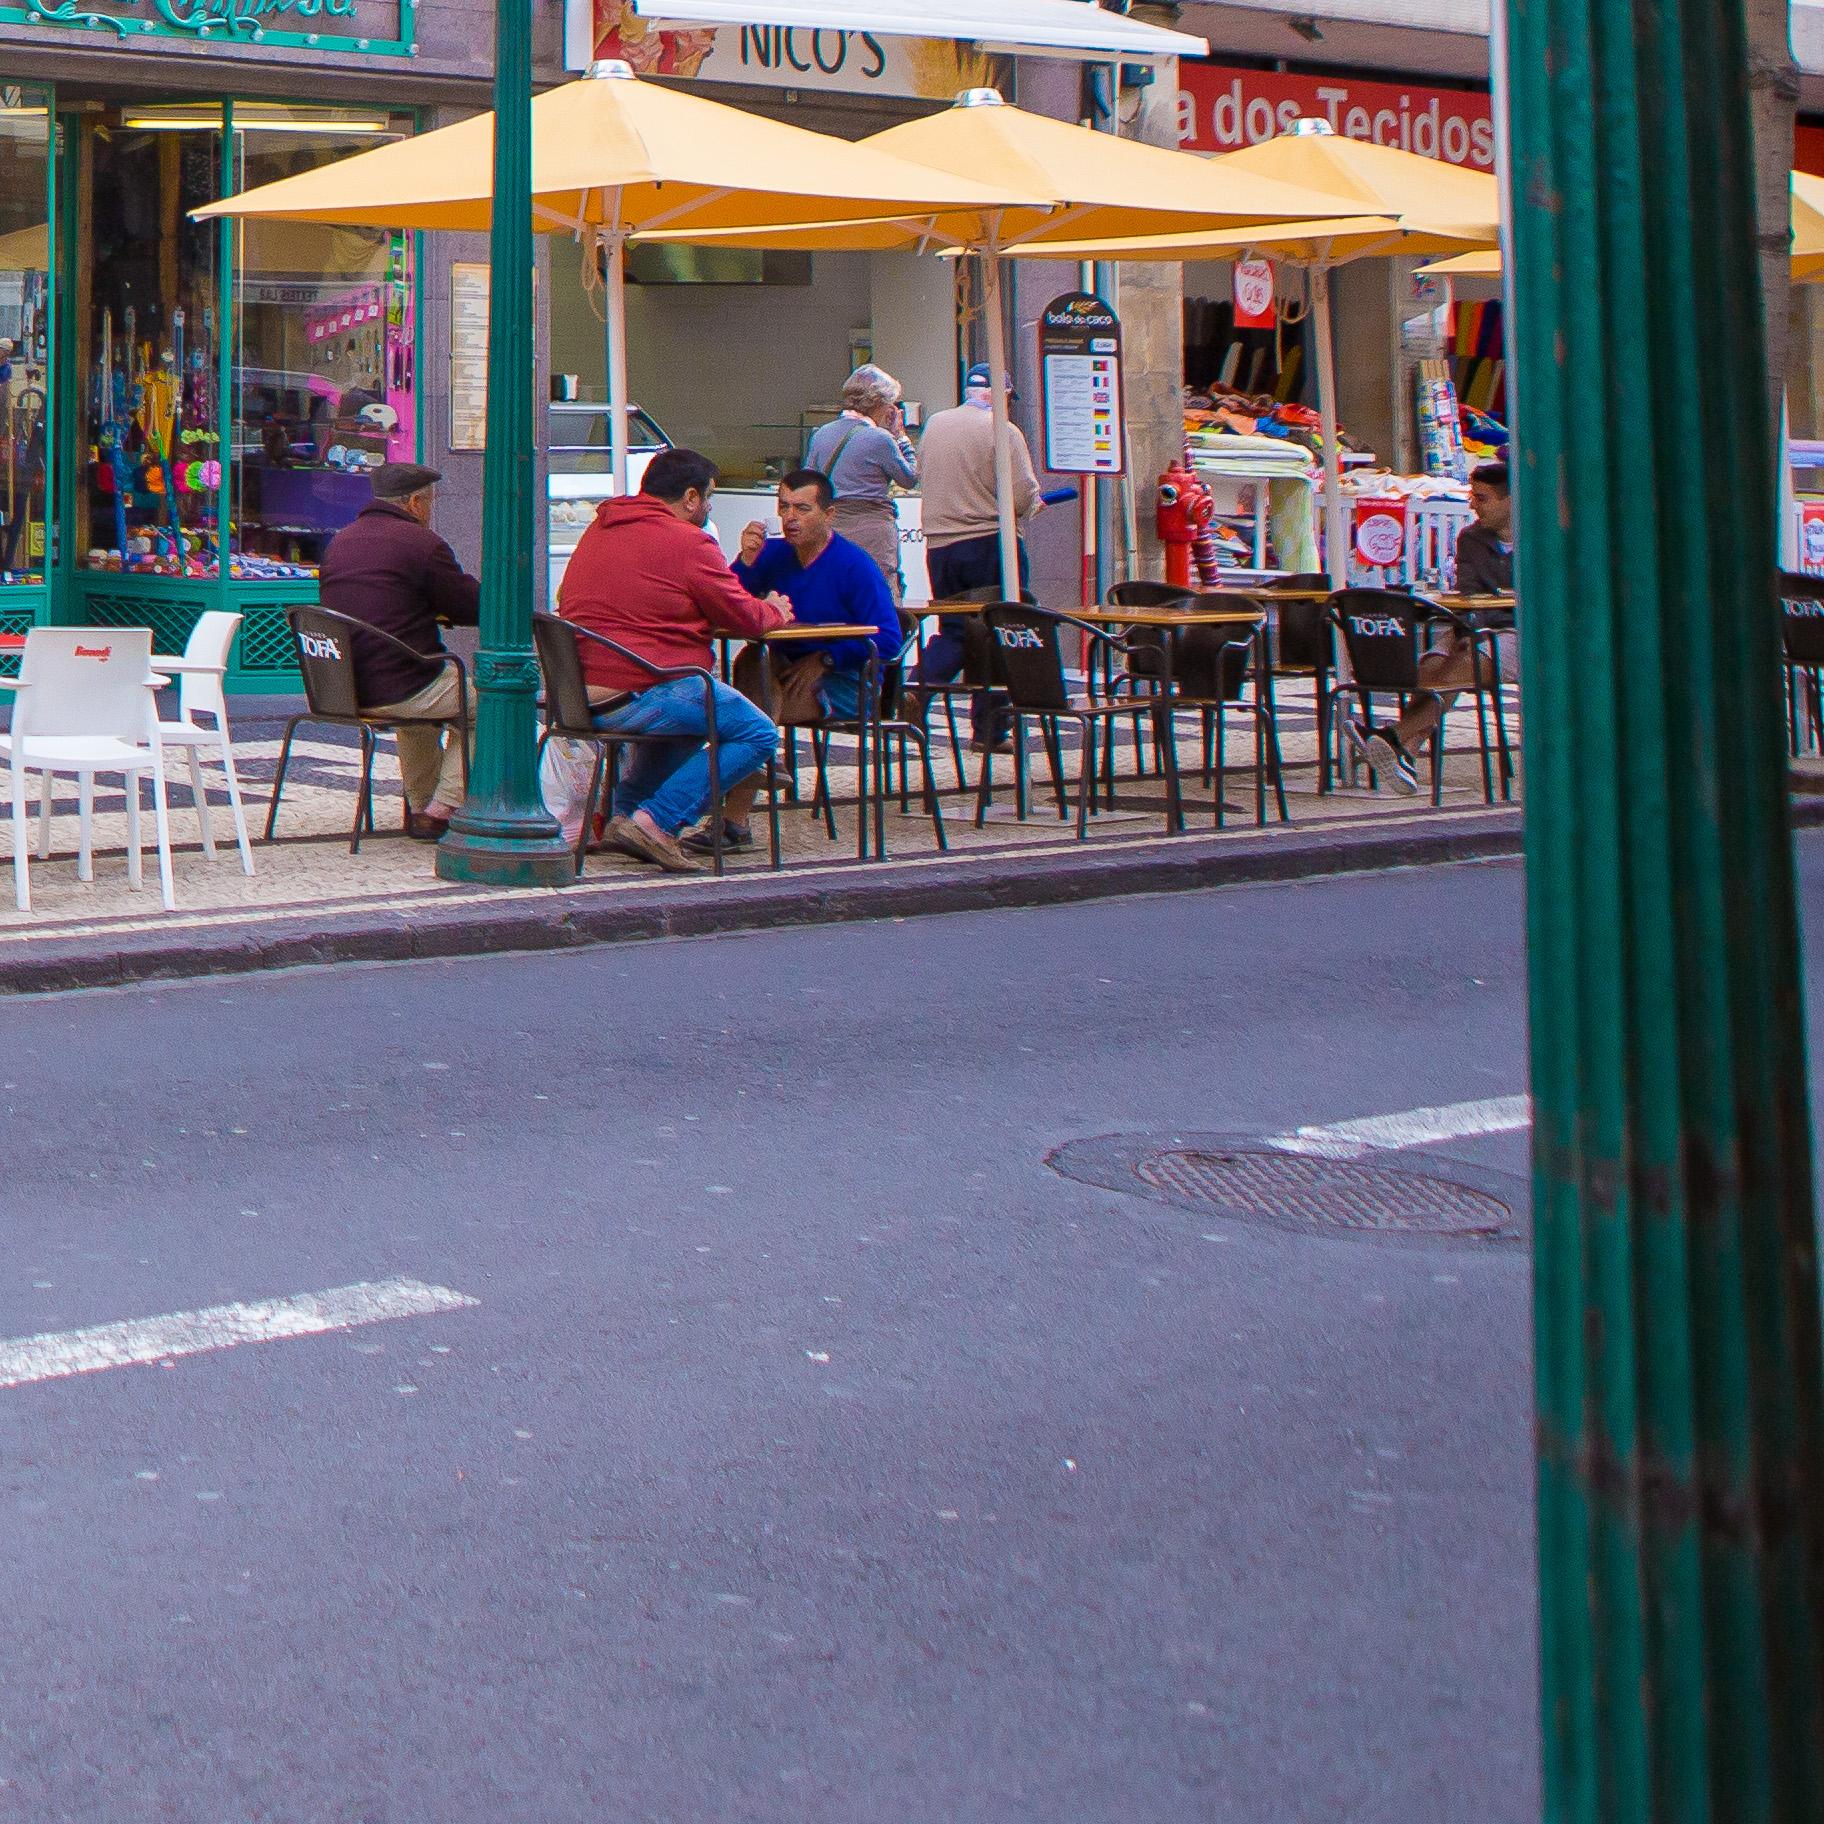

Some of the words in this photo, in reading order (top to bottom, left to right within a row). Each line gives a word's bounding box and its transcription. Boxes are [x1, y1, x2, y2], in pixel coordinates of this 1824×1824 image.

[1213, 79, 1302, 145] dos
[1316, 86, 1495, 165] Tecidos
[993, 626, 1044, 647] TOFA
[1348, 616, 1406, 636] TOFA
[297, 632, 342, 660] TOFA
